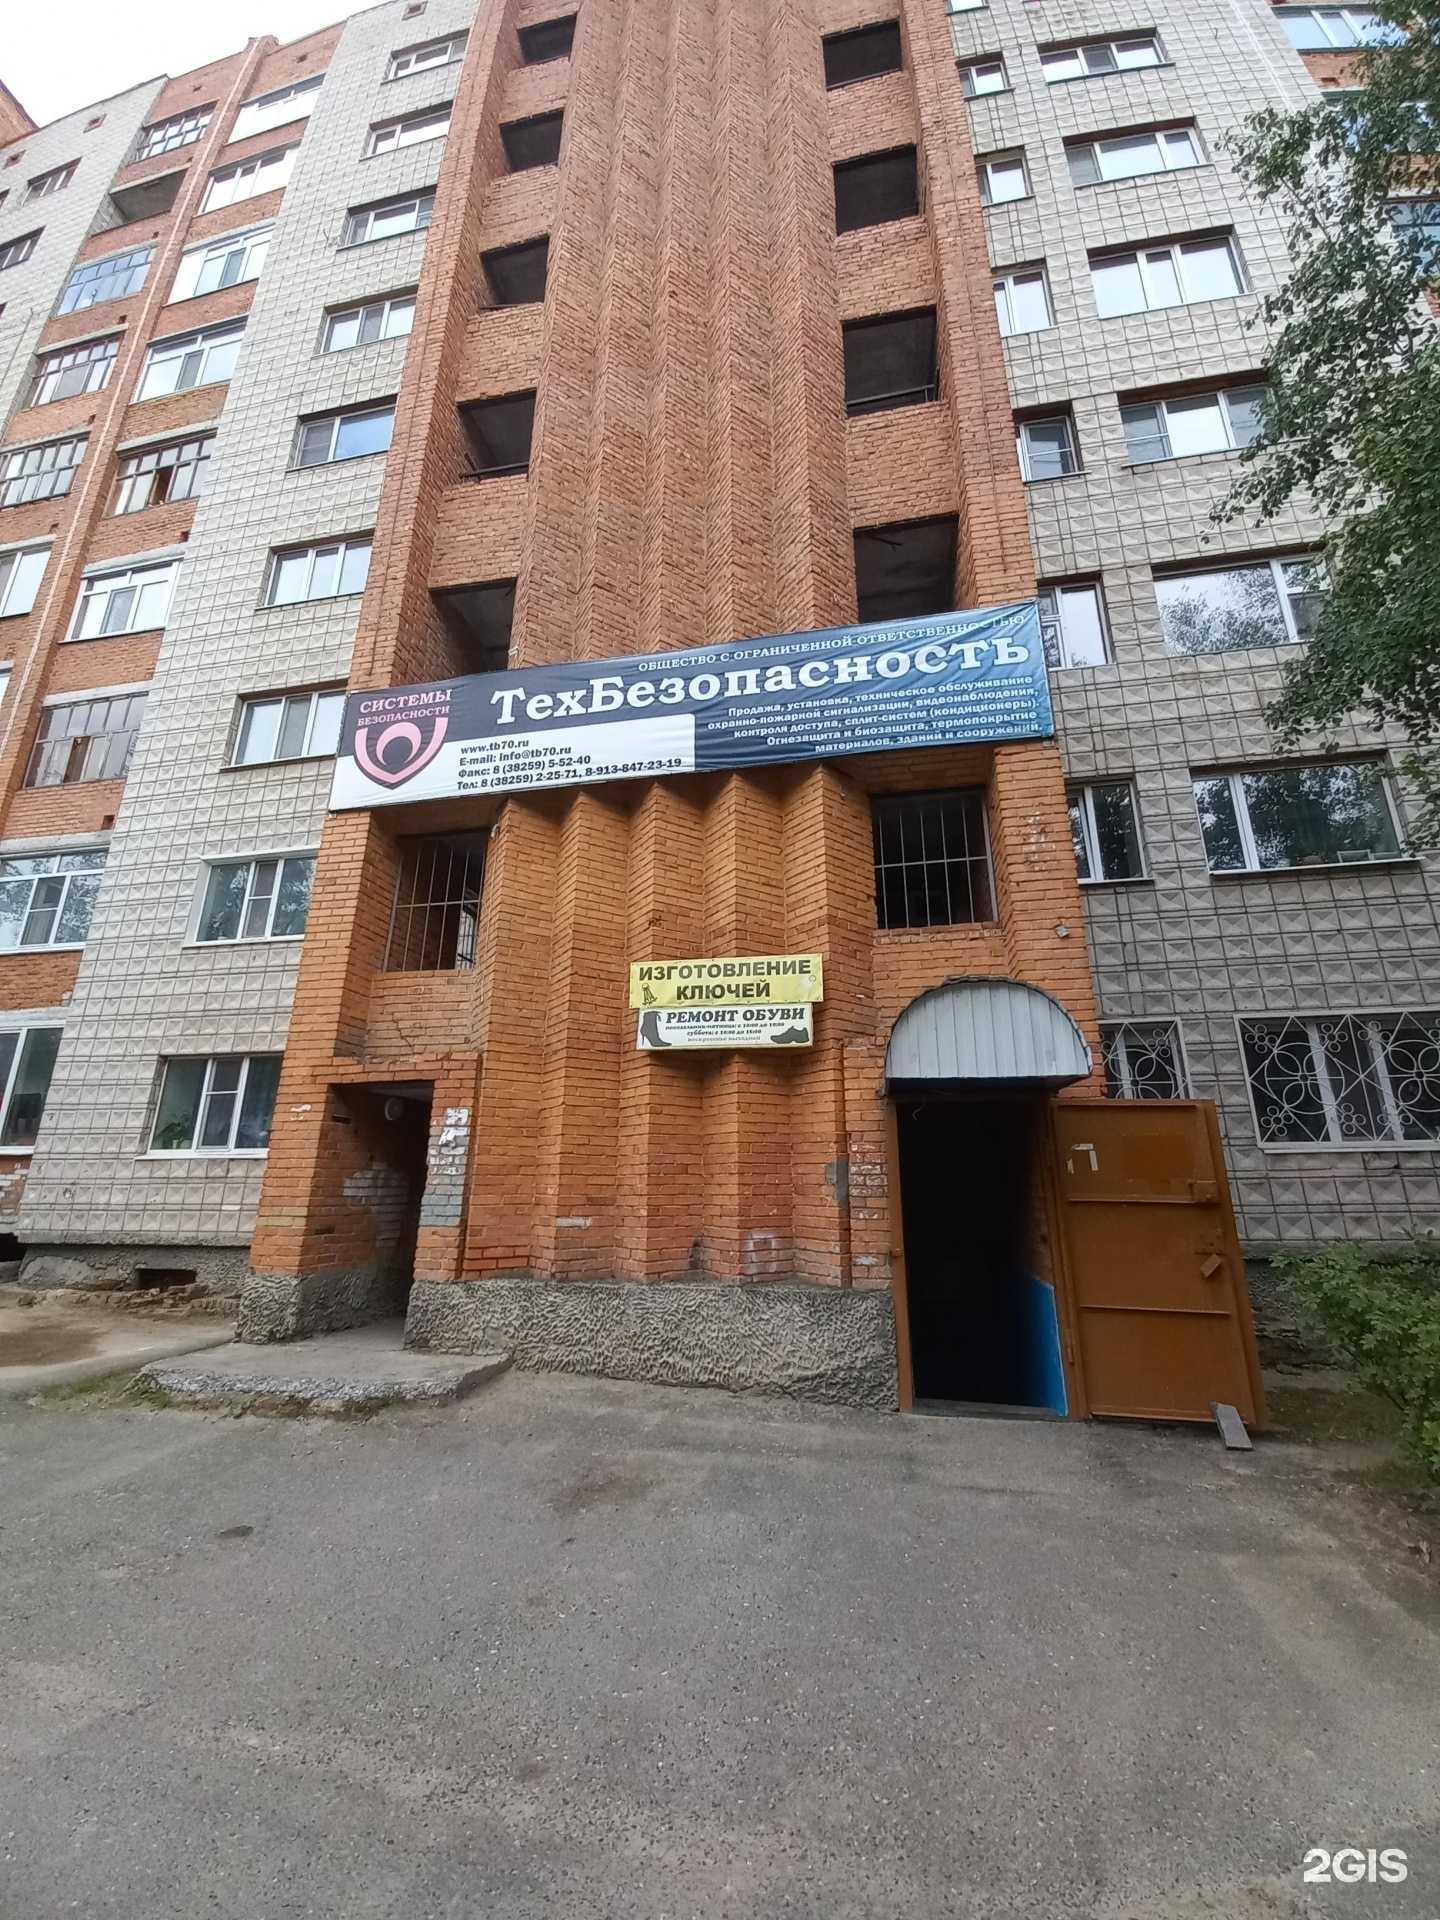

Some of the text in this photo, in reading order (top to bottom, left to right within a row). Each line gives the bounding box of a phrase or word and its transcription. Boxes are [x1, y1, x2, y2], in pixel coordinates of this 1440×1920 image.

[638, 614, 1025, 672] ОБЩЕСТВО С ОГРАНИЧЕННОЙ ОТВЕТСТВЕННОСТЬЮ
[490, 637, 1029, 725] ТехБезопасность
[359, 689, 453, 714] СИСТЕМЫ
[707, 688, 1039, 730] охранно-пожарной сигнализации, видеонаблюдения,
[728, 676, 1033, 717] Продажа, установка, техническое обслуживание
[357, 705, 450, 726] БЕЗОПАСНОСТИ
[767, 710, 1038, 746] Огнезащита и биозащита, термопокрытие
[790, 719, 842, 733] доступа,
[844, 709, 927, 726] сплит-систем
[930, 699, 1039, 718] (кондиционеры).
[896, 730, 943, 745] зданий
[945, 731, 954, 739] и
[957, 720, 1043, 738] сооружений.
[459, 746, 571, 767] E-mail: info@tb70.ru
[460, 738, 529, 754] www.tb70.ru
[456, 758, 682, 790] Тел: 8 (38259) 2-25-71, 8-913-847-23-19
[458, 755, 591, 779] Факс: 8 (38259) 5-52-40
[639, 959, 811, 981] ИЗГОТОВЛЕНИЕ
[676, 979, 771, 1000] КЛЮЧЕЙ
[666, 1007, 805, 1024] РЕМОНТ ОБУВИ
